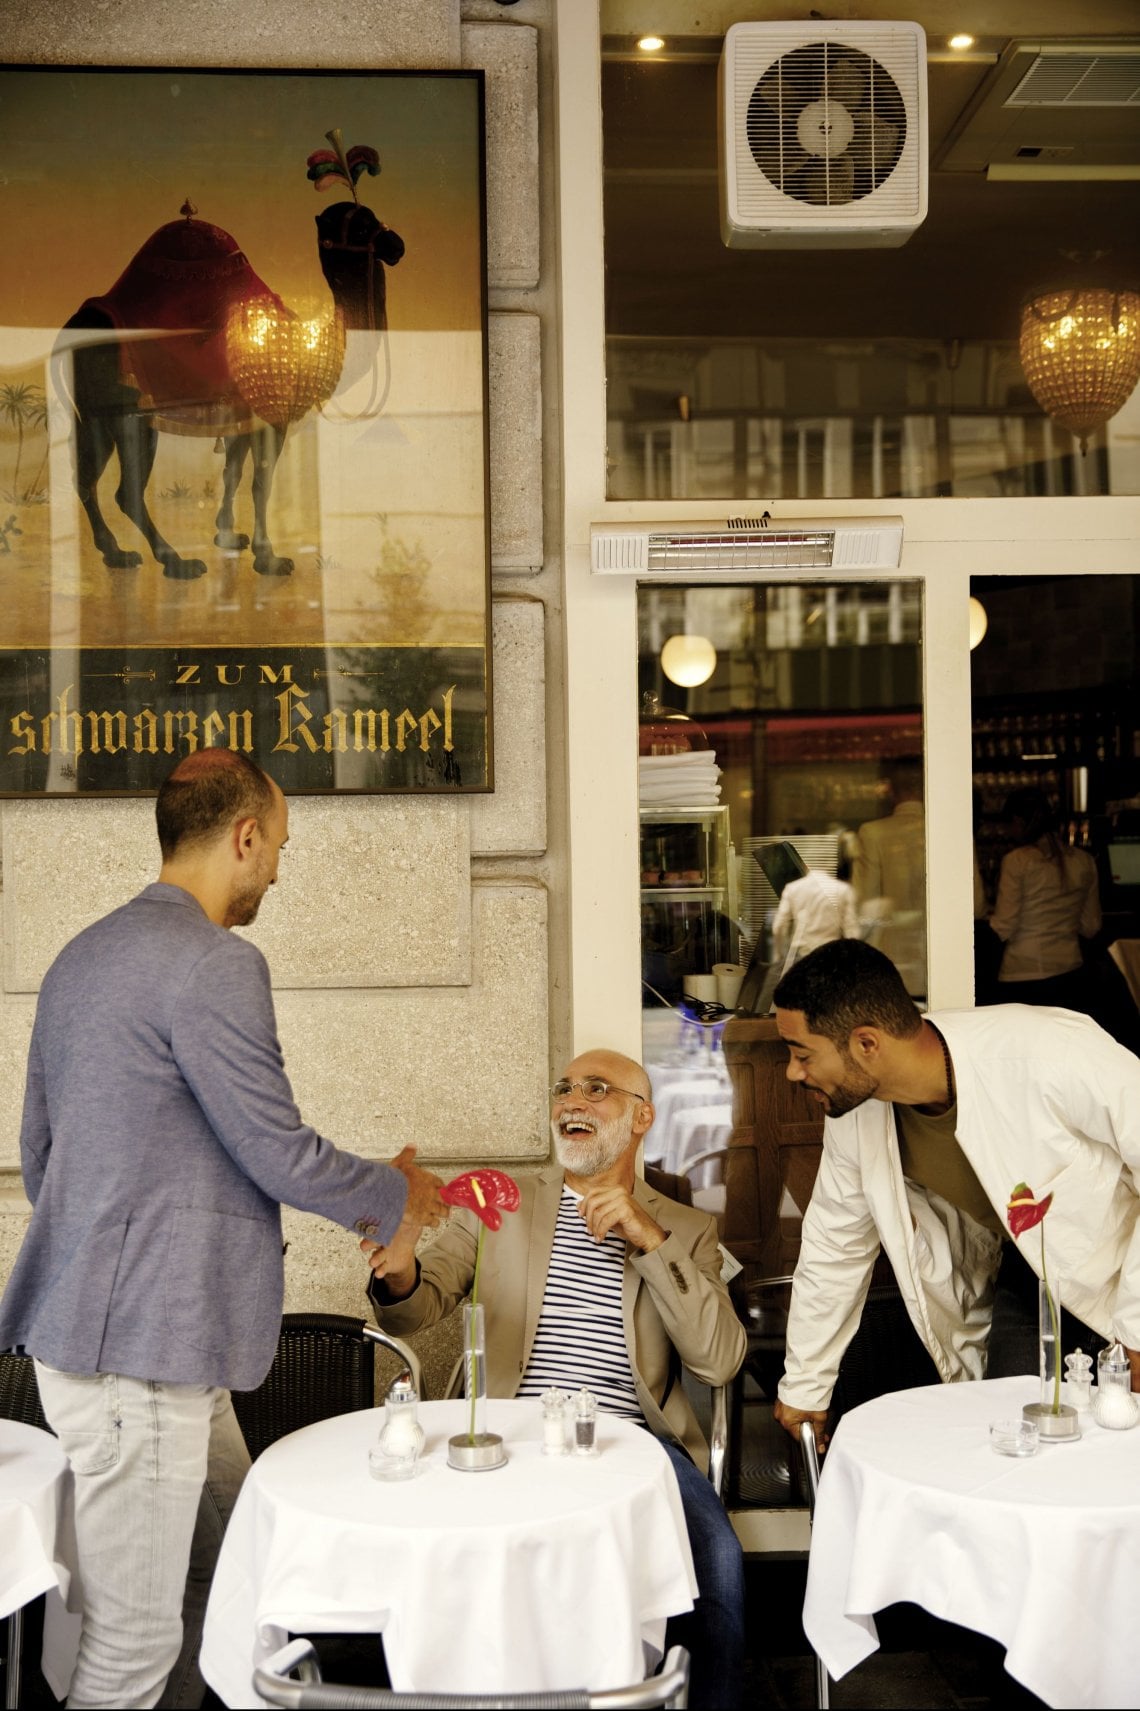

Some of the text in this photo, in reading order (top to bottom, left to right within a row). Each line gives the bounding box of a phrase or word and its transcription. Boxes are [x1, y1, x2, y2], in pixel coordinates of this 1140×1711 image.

[176, 665, 293, 685] ZUM
[8, 683, 457, 769] schwarzen Kameel
